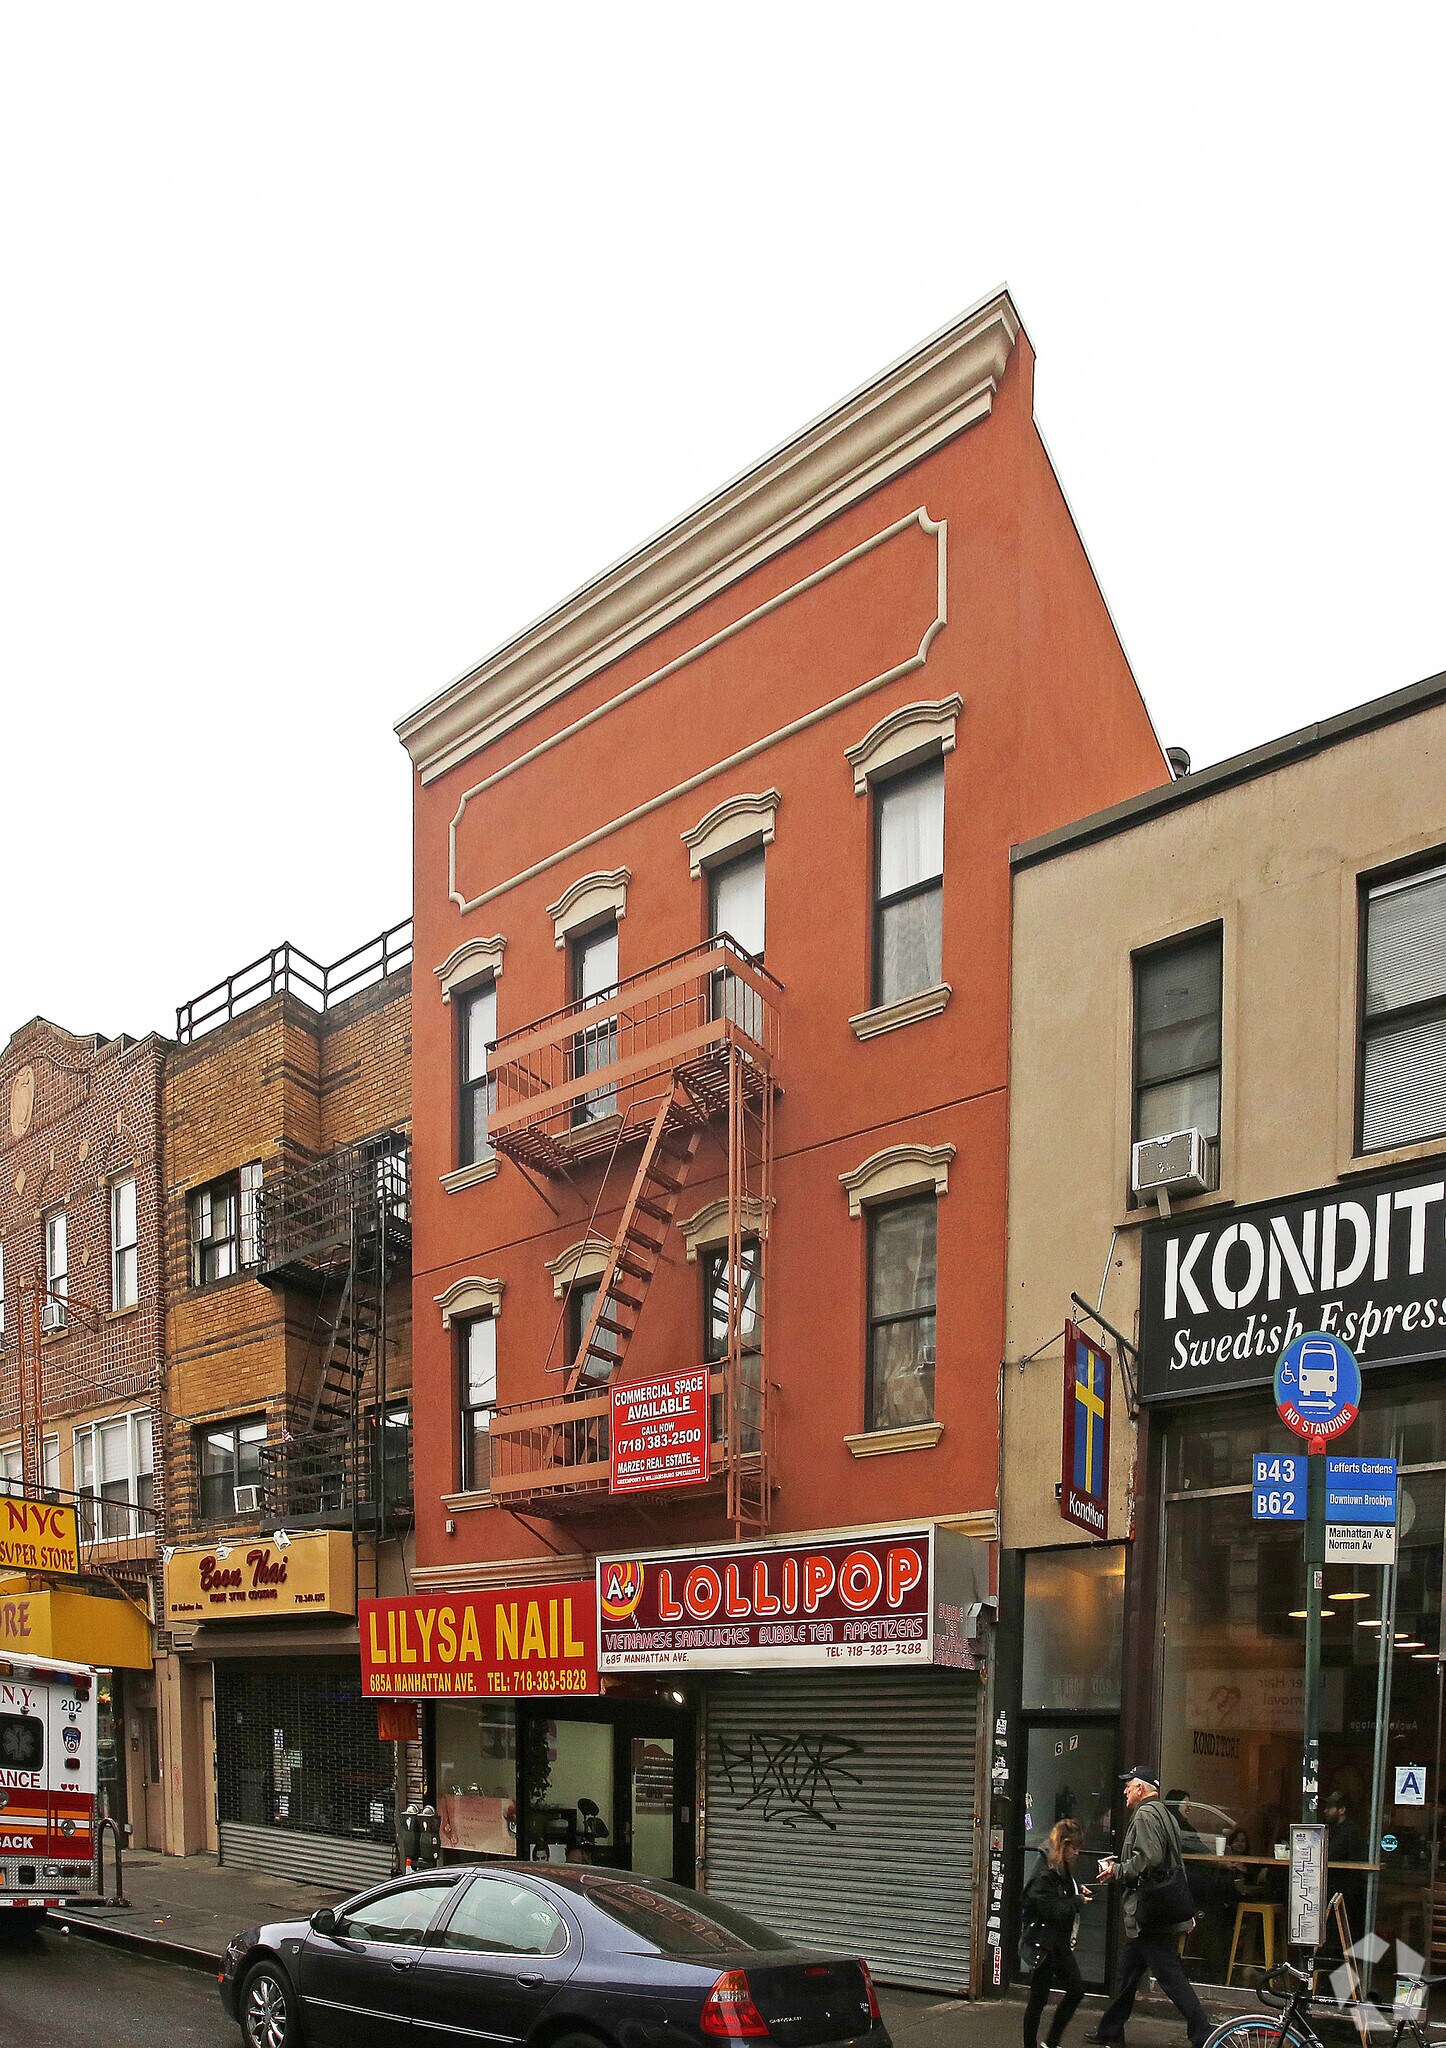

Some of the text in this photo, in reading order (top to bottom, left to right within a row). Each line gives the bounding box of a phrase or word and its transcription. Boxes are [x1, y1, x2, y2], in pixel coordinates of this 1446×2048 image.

[1164, 1181, 1446, 1320] KONDIT
[1169, 1306, 1303, 1370] Swedish
[615, 1376, 703, 1406] COMMERCIAL SPACE
[627, 1395, 690, 1420] AVAILABLE
[641, 1422, 675, 1436] CALL NOW
[1284, 1407, 1352, 1435] NO STANDING
[618, 1428, 701, 1454] (718) 383-2500
[617, 1460, 645, 1474] MARZEC
[646, 1457, 664, 1470] REAL
[1257, 1459, 1295, 1482] B43
[1329, 1461, 1393, 1474] Lefferts Gardens
[1069, 1490, 1104, 1530] Konditori
[1257, 1491, 1295, 1515] B62
[1329, 1493, 1393, 1507] Downtown Brooklyn
[4, 1500, 66, 1539] NYC
[1328, 1527, 1392, 1539] Manhattan Av &
[1328, 1540, 1373, 1550] Norman Av
[0, 1541, 76, 1571] SUPER STORE
[199, 1549, 288, 1591] Boon Thai
[658, 1547, 923, 1622] LOLLIPOP
[0, 1601, 32, 1638] RE
[369, 1597, 585, 1664] LILYSA NAIL
[605, 1617, 923, 1650] VIETNAMESE SANDWICHES BUBBLE TEA APPETIZERS
[605, 1652, 690, 1665] 685 MANHATTAN AVE.
[826, 1642, 922, 1658] TEL: 718-383-3288
[370, 1668, 587, 1692] 685A MANHATTAN AVE. TEL: 718-383-5828
[61, 1699, 82, 1713] 202
[1400, 1771, 1420, 1795] A
[0, 1835, 34, 1849] ACK
